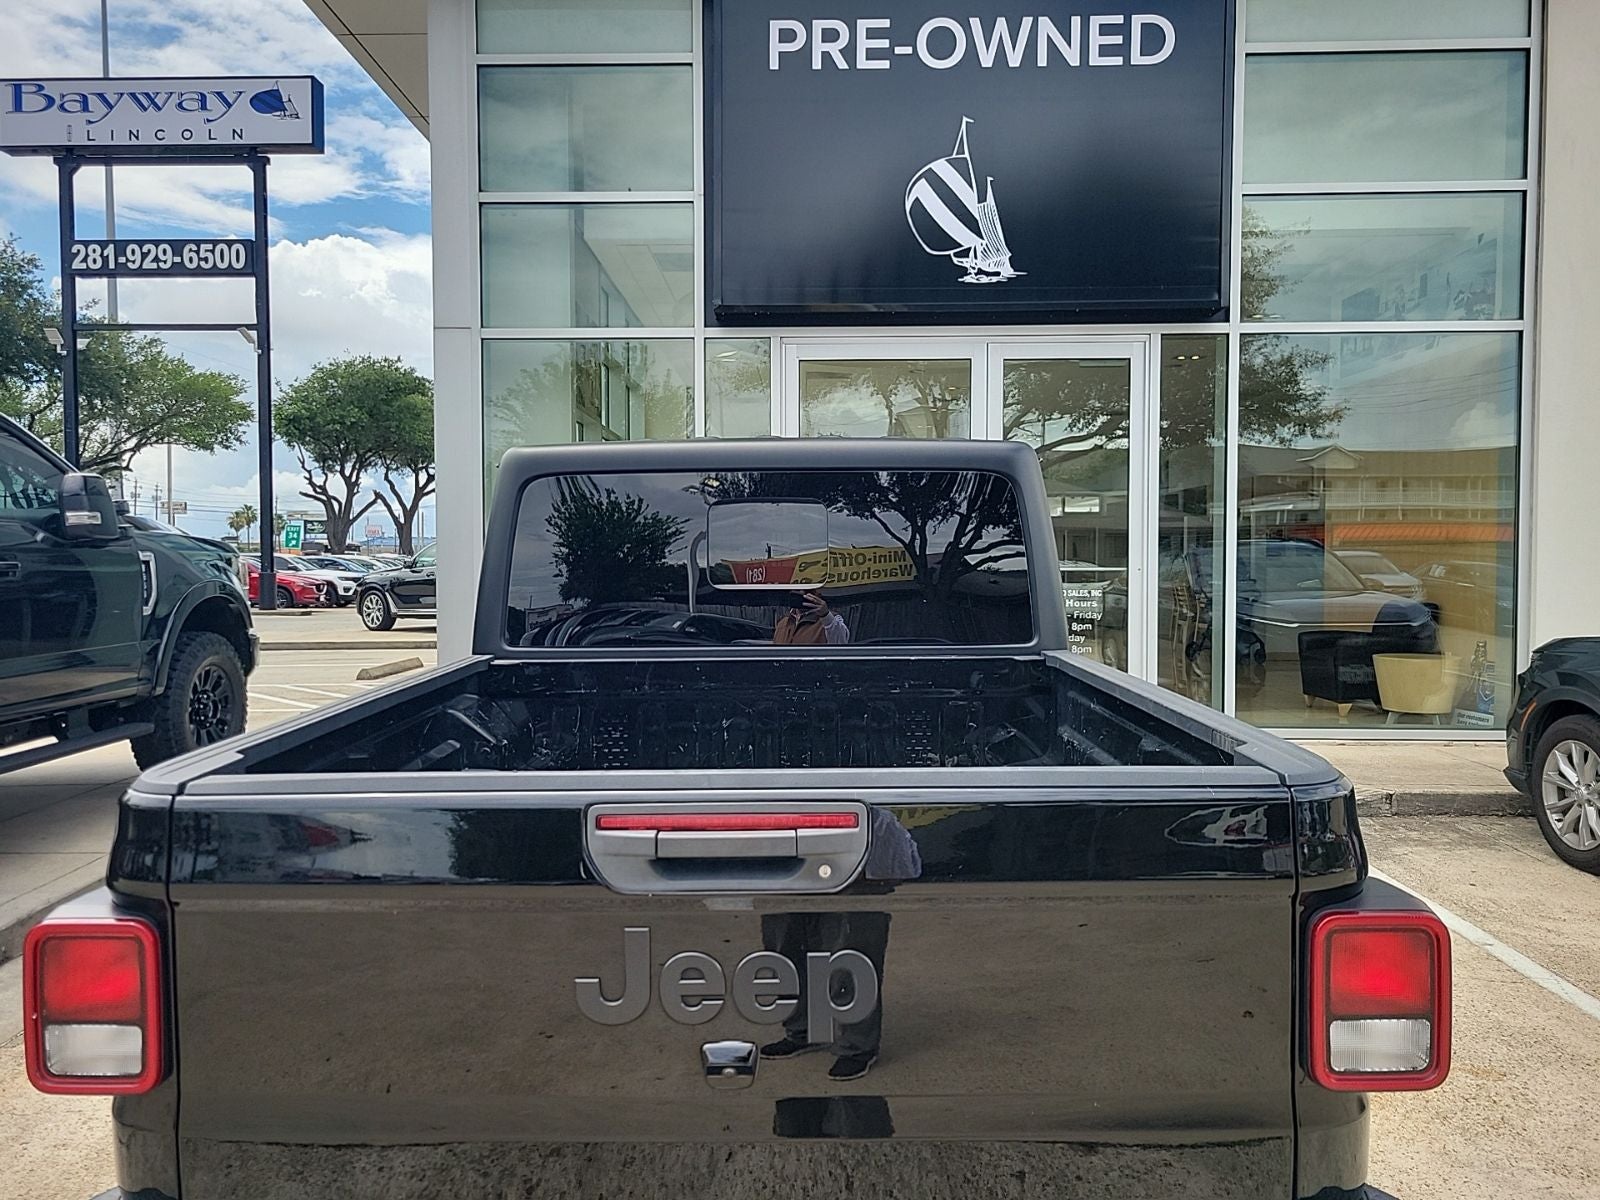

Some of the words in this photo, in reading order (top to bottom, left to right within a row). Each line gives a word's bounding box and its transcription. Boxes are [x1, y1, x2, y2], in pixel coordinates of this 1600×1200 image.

[768, 14, 1176, 70] PRE-OWNED
[5, 82, 246, 126] Bayway
[86, 128, 245, 142] LINCOLN
[71, 243, 246, 270] 281-929-6500
[1065, 599, 1098, 607] Hours
[1073, 611, 1103, 620] Friday
[1071, 622, 1092, 632] 8pm
[1068, 634, 1086, 643] day
[1071, 645, 1092, 654] 8pm
[575, 927, 878, 1044] Jeep
